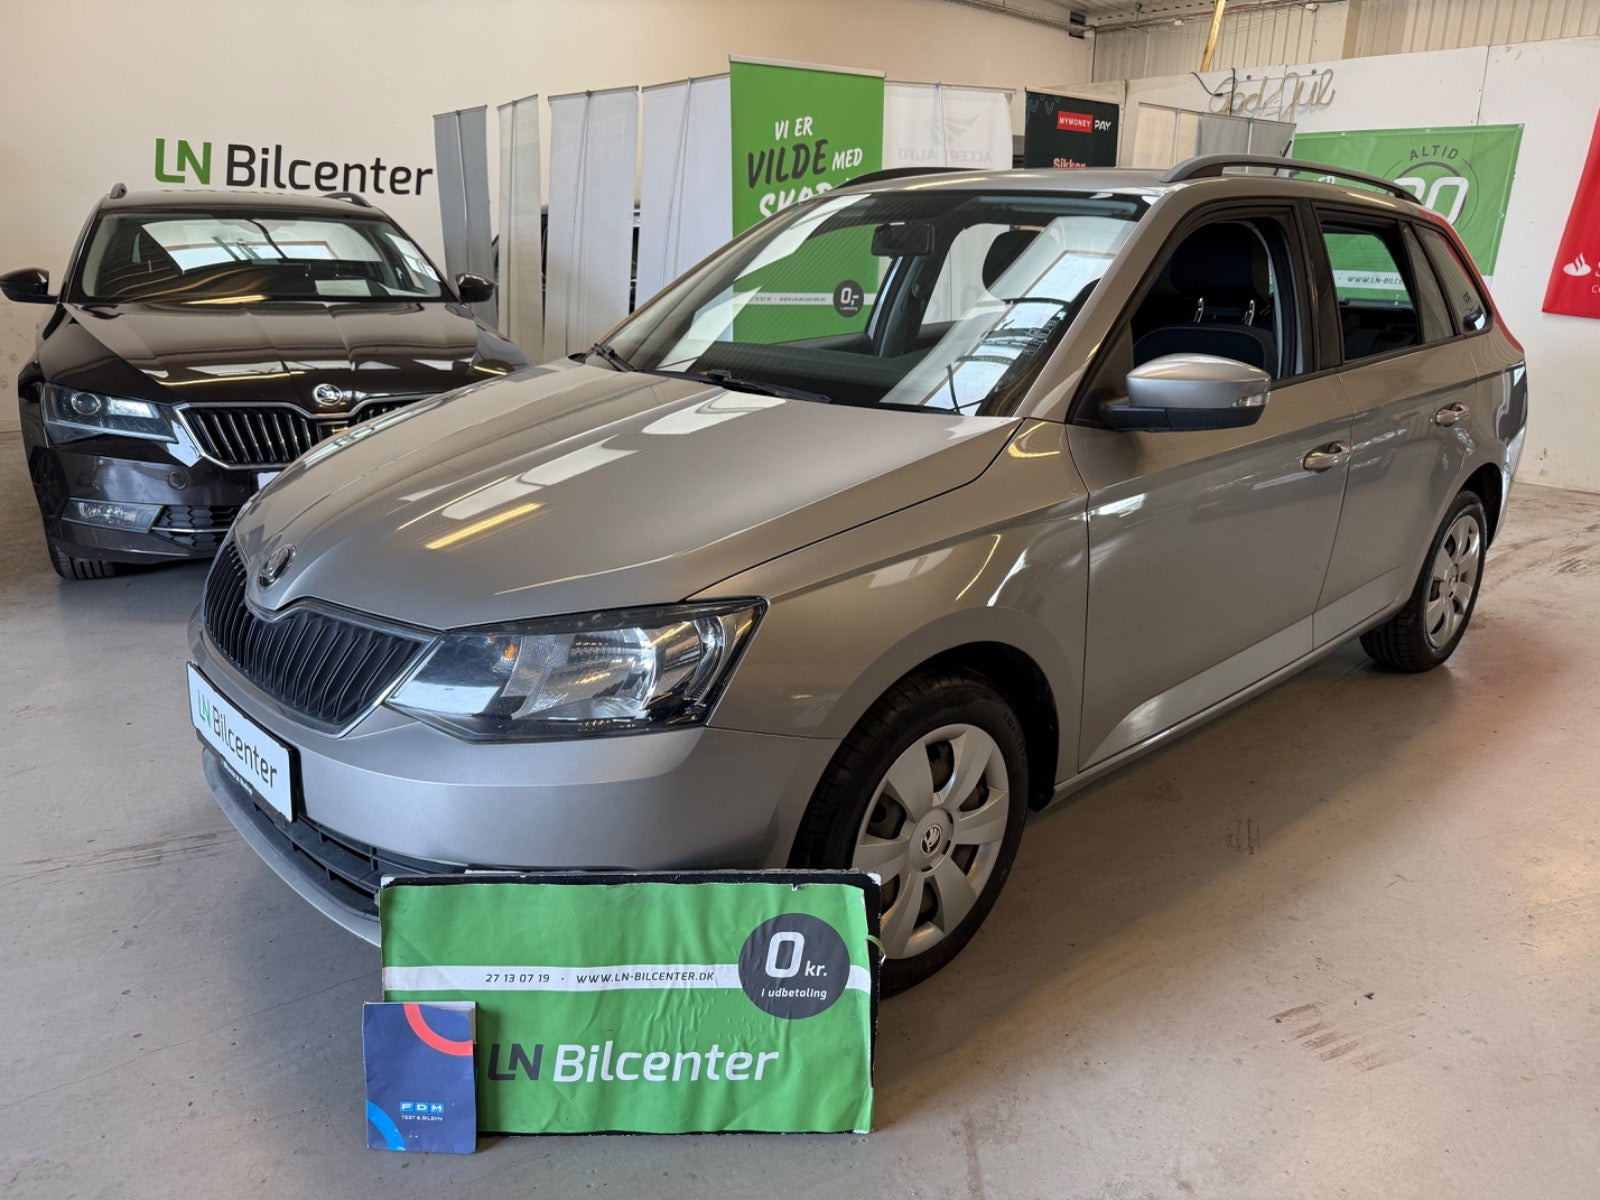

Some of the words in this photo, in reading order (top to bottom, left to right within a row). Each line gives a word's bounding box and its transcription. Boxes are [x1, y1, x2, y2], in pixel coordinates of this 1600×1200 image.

[775, 119, 789, 141] VI
[794, 116, 813, 137] ER
[1059, 116, 1092, 128] MYMONEY
[1094, 119, 1112, 131] PAY
[155, 138, 212, 185] LN
[226, 143, 433, 195] Bilcenter
[748, 138, 828, 189] VILDE
[831, 147, 863, 171] MED
[1409, 144, 1459, 162] ALTID
[197, 690, 211, 728] LN
[212, 705, 278, 788] Bilcenter
[765, 931, 805, 978] 0
[804, 960, 828, 977] kr.
[486, 973, 500, 983] 27
[504, 973, 515, 983] 13
[519, 973, 533, 983] 07
[538, 973, 550, 983] 19
[576, 971, 715, 984] WWW.LN-BILCENTER.DK
[768, 987, 828, 1001] udbetaling
[487, 1043, 544, 1081] LN
[553, 1040, 780, 1083] Bilcenter
